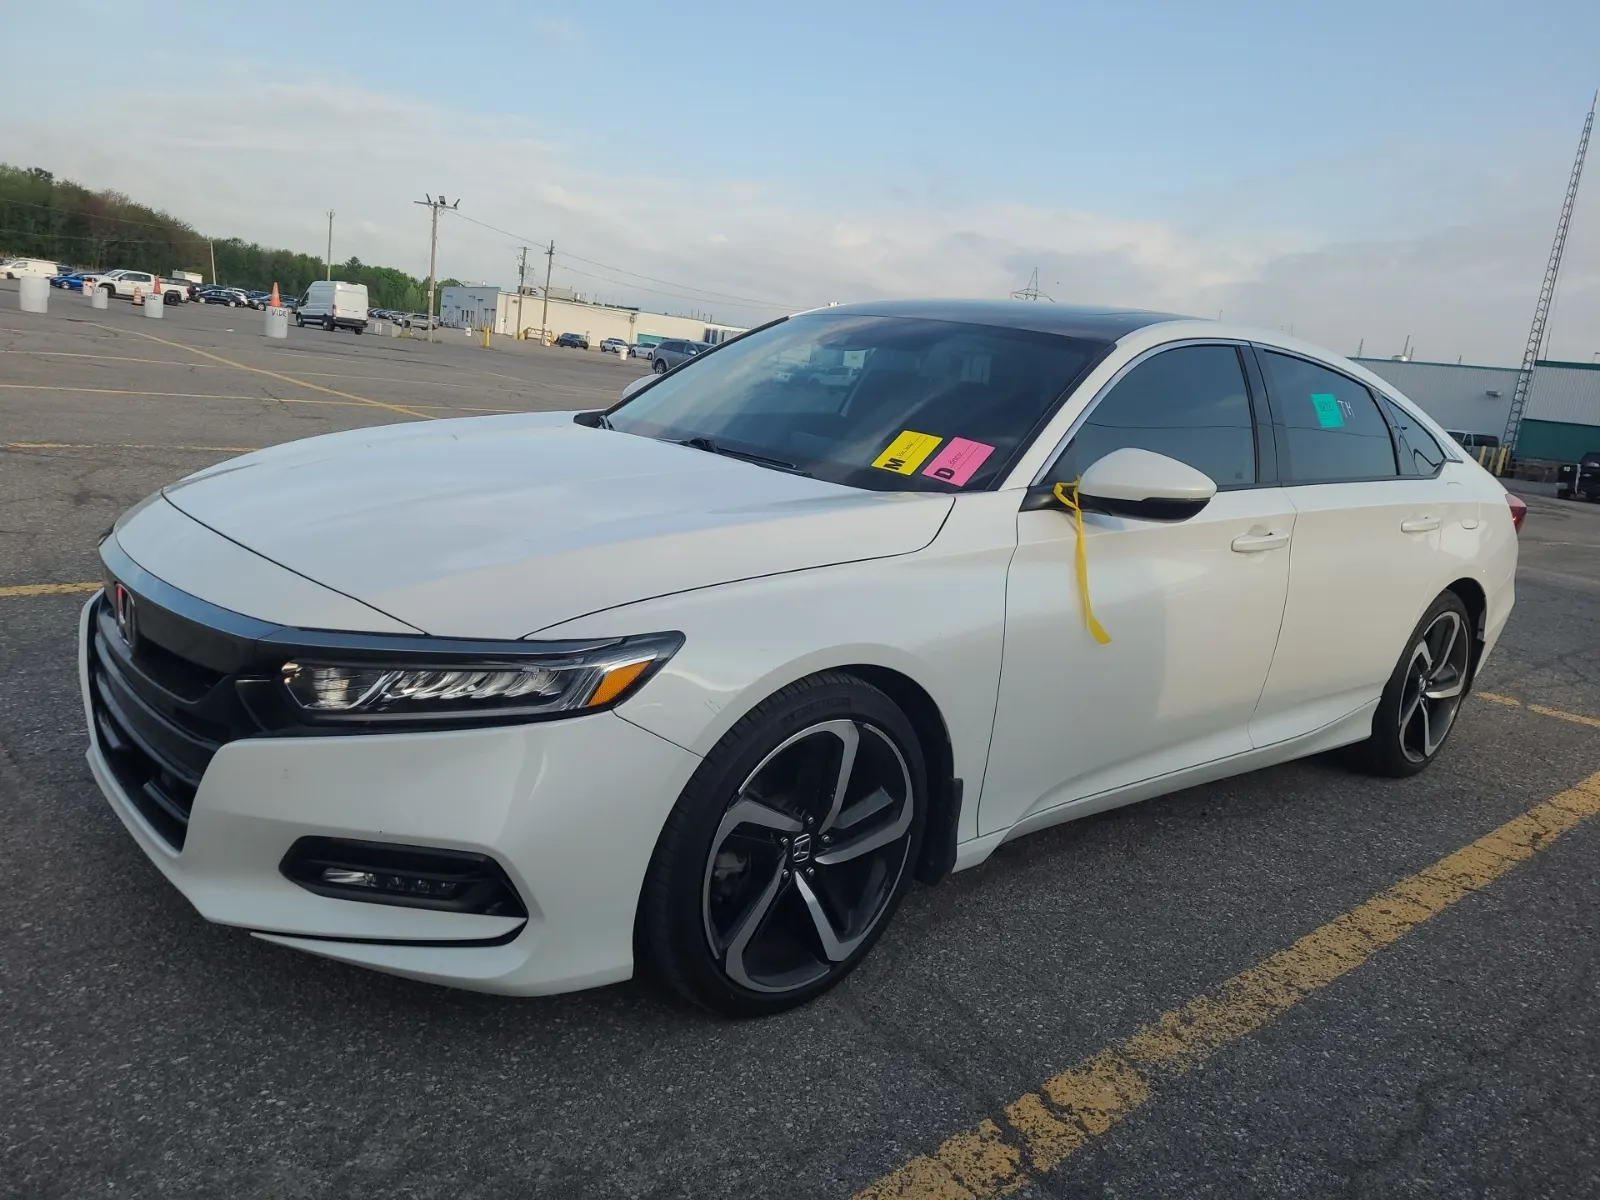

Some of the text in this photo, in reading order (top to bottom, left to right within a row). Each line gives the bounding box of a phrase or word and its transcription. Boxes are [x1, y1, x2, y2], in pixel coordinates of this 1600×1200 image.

[271, 308, 287, 318] VIDE
[1337, 400, 1356, 418] TH
[883, 457, 906, 470] M
[933, 467, 956, 480] D
